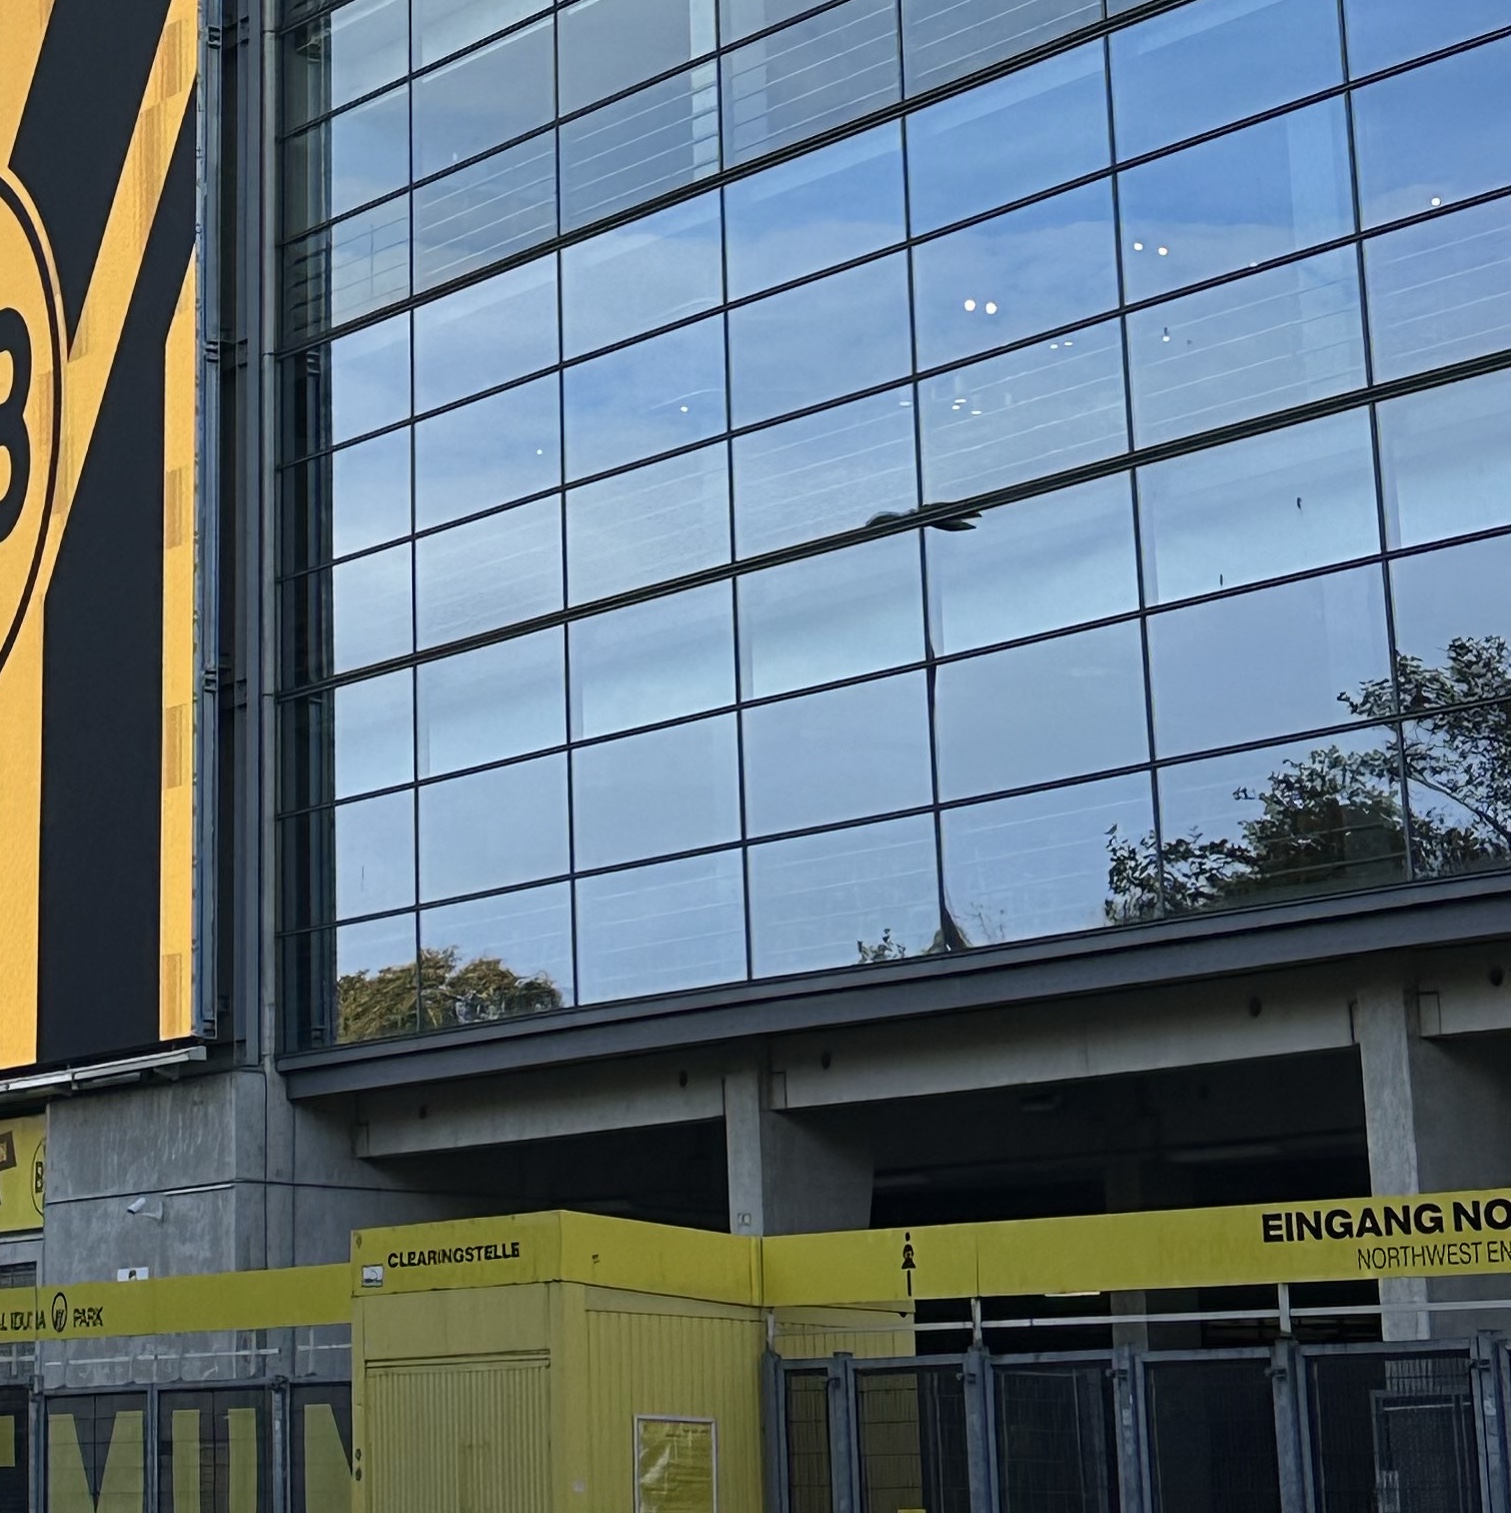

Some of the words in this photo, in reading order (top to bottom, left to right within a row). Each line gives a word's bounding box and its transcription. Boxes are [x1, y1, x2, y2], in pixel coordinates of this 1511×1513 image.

[1261, 1202, 1445, 1244] EINGANG
[1452, 1197, 1511, 1234] NO
[387, 1241, 521, 1269] CLEARINGSTELLE
[1357, 1241, 1483, 1271] NORTHWEST
[73, 1305, 104, 1329] PARK
